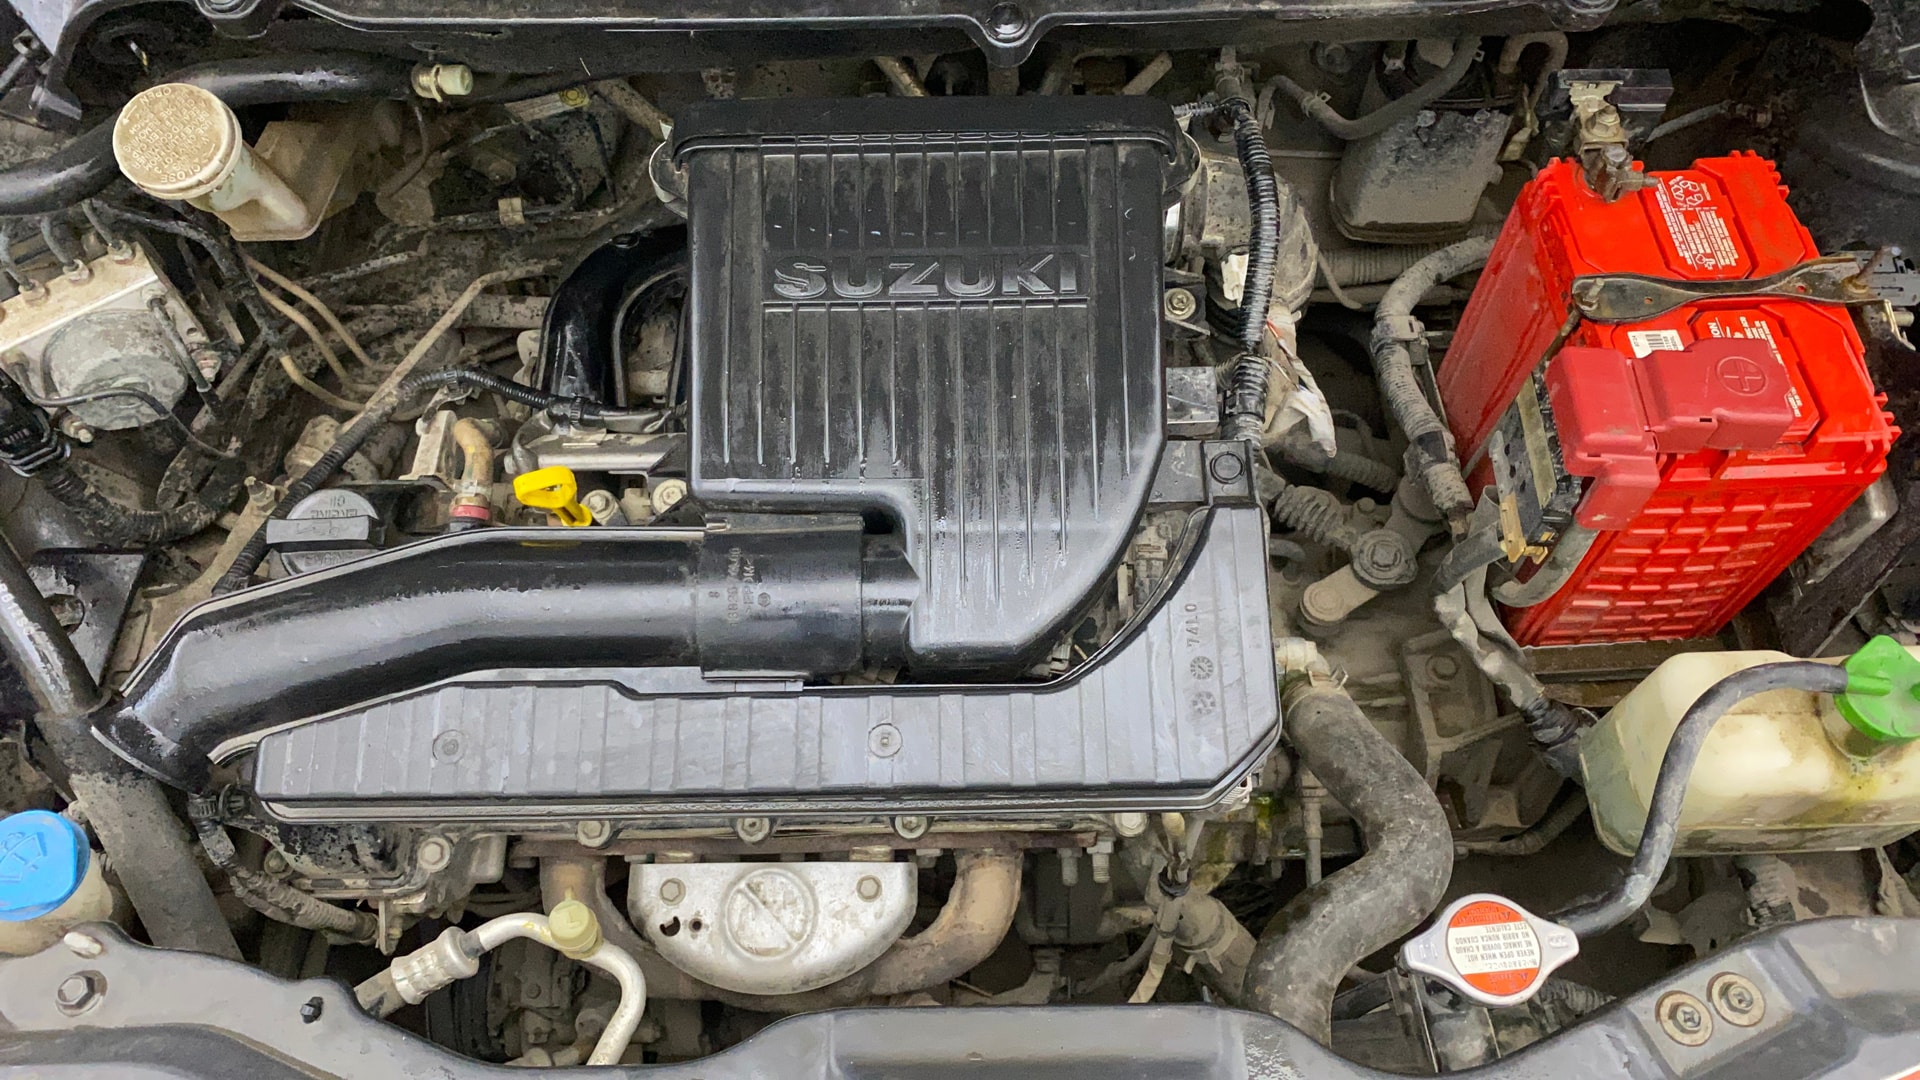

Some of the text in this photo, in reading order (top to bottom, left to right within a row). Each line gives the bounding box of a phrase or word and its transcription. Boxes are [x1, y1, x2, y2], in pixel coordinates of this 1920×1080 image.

[140, 87, 172, 105] OPEN
[121, 90, 189, 153] BEFORE REMOVING
[170, 105, 200, 134] SEALED
[142, 109, 209, 172] BRAKE FLUID FROM
[152, 118, 212, 175] USE ONLY DOT 3
[129, 141, 148, 159] CAP
[131, 130, 174, 170] CONTAINER
[160, 164, 201, 183] CLOSE
[774, 255, 1077, 299] SUZUKI
[567, 911, 582, 928] L
[1513, 921, 1527, 930] ESTE
[1454, 930, 1529, 945] NO ABRIR NUNCA CUANDO
[1502, 939, 1522, 949] JAMAIS
[1523, 939, 1532, 947] NE
[1481, 942, 1501, 951] OUVRIR
[1498, 950, 1514, 959] OPEN
[1515, 947, 1535, 957] NEVER
[1479, 951, 1497, 961] WHEN
